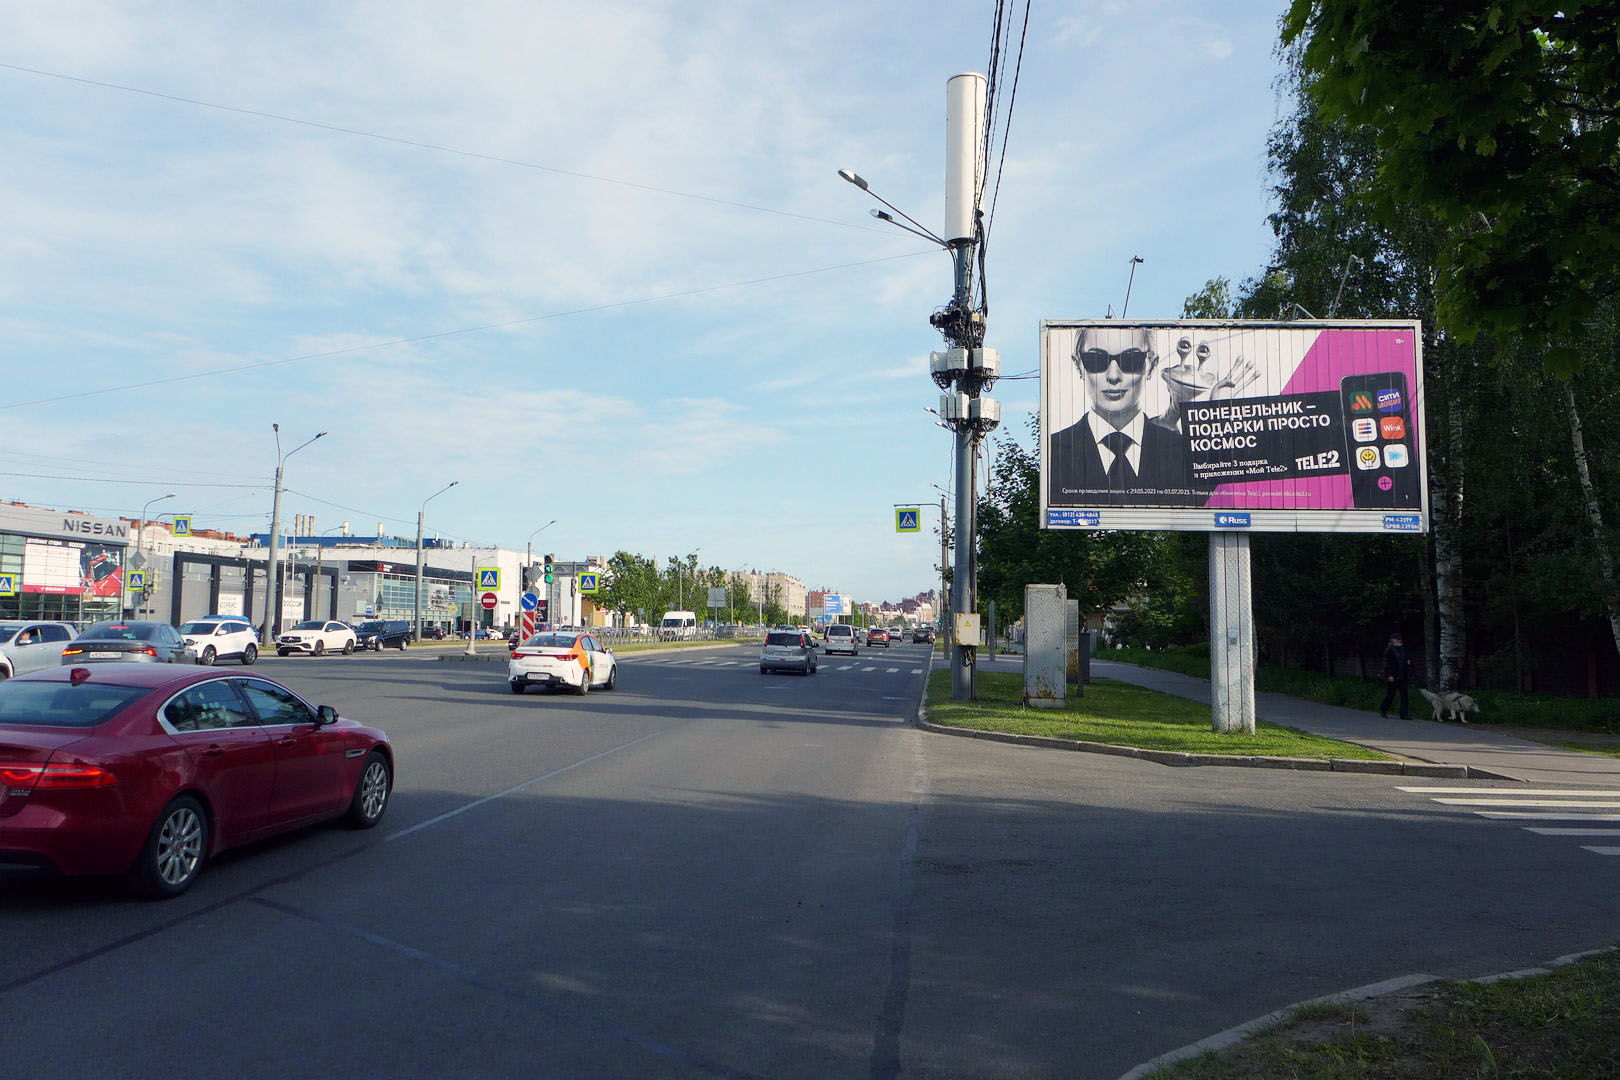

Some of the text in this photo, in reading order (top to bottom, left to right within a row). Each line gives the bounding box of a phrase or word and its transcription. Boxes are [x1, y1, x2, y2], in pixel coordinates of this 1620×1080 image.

[1187, 401, 1303, 421] ПОНЕДЕЛЬНИК
[1189, 414, 1331, 437] ПОДАРКИ ПРОСТО
[1383, 424, 1402, 432] Wink
[1190, 435, 1257, 451] КОСМОС
[1193, 462, 1231, 470] Выбирайте
[1239, 459, 1268, 467] подарка
[1295, 450, 1340, 471] TELE2
[1200, 470, 1244, 480] приложении
[63, 519, 126, 538] NISSAN
